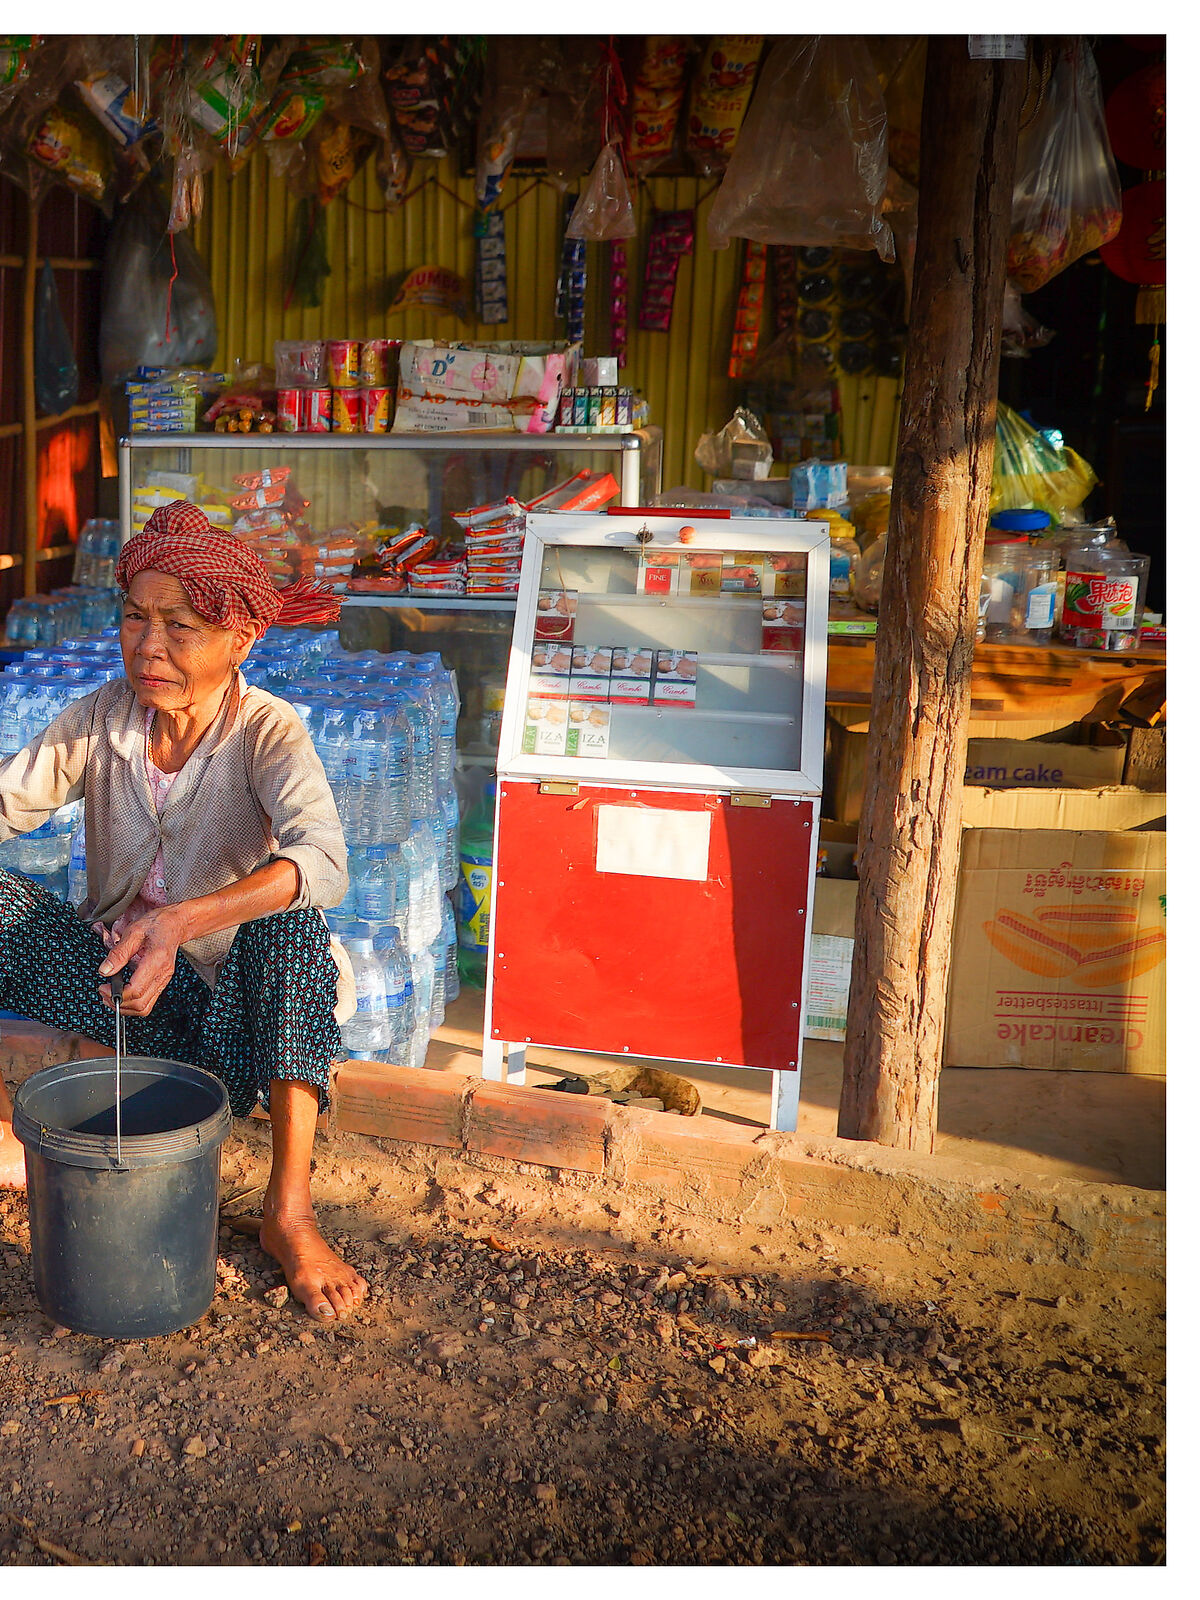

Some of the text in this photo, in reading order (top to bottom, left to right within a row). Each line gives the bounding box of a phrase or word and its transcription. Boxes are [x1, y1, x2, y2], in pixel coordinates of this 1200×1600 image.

[648, 574, 667, 582] FINE
[540, 731, 563, 741] IZA
[582, 734, 606, 744] IZA
[1013, 764, 1064, 783] cake
[997, 1023, 1144, 1051] Creamcake
